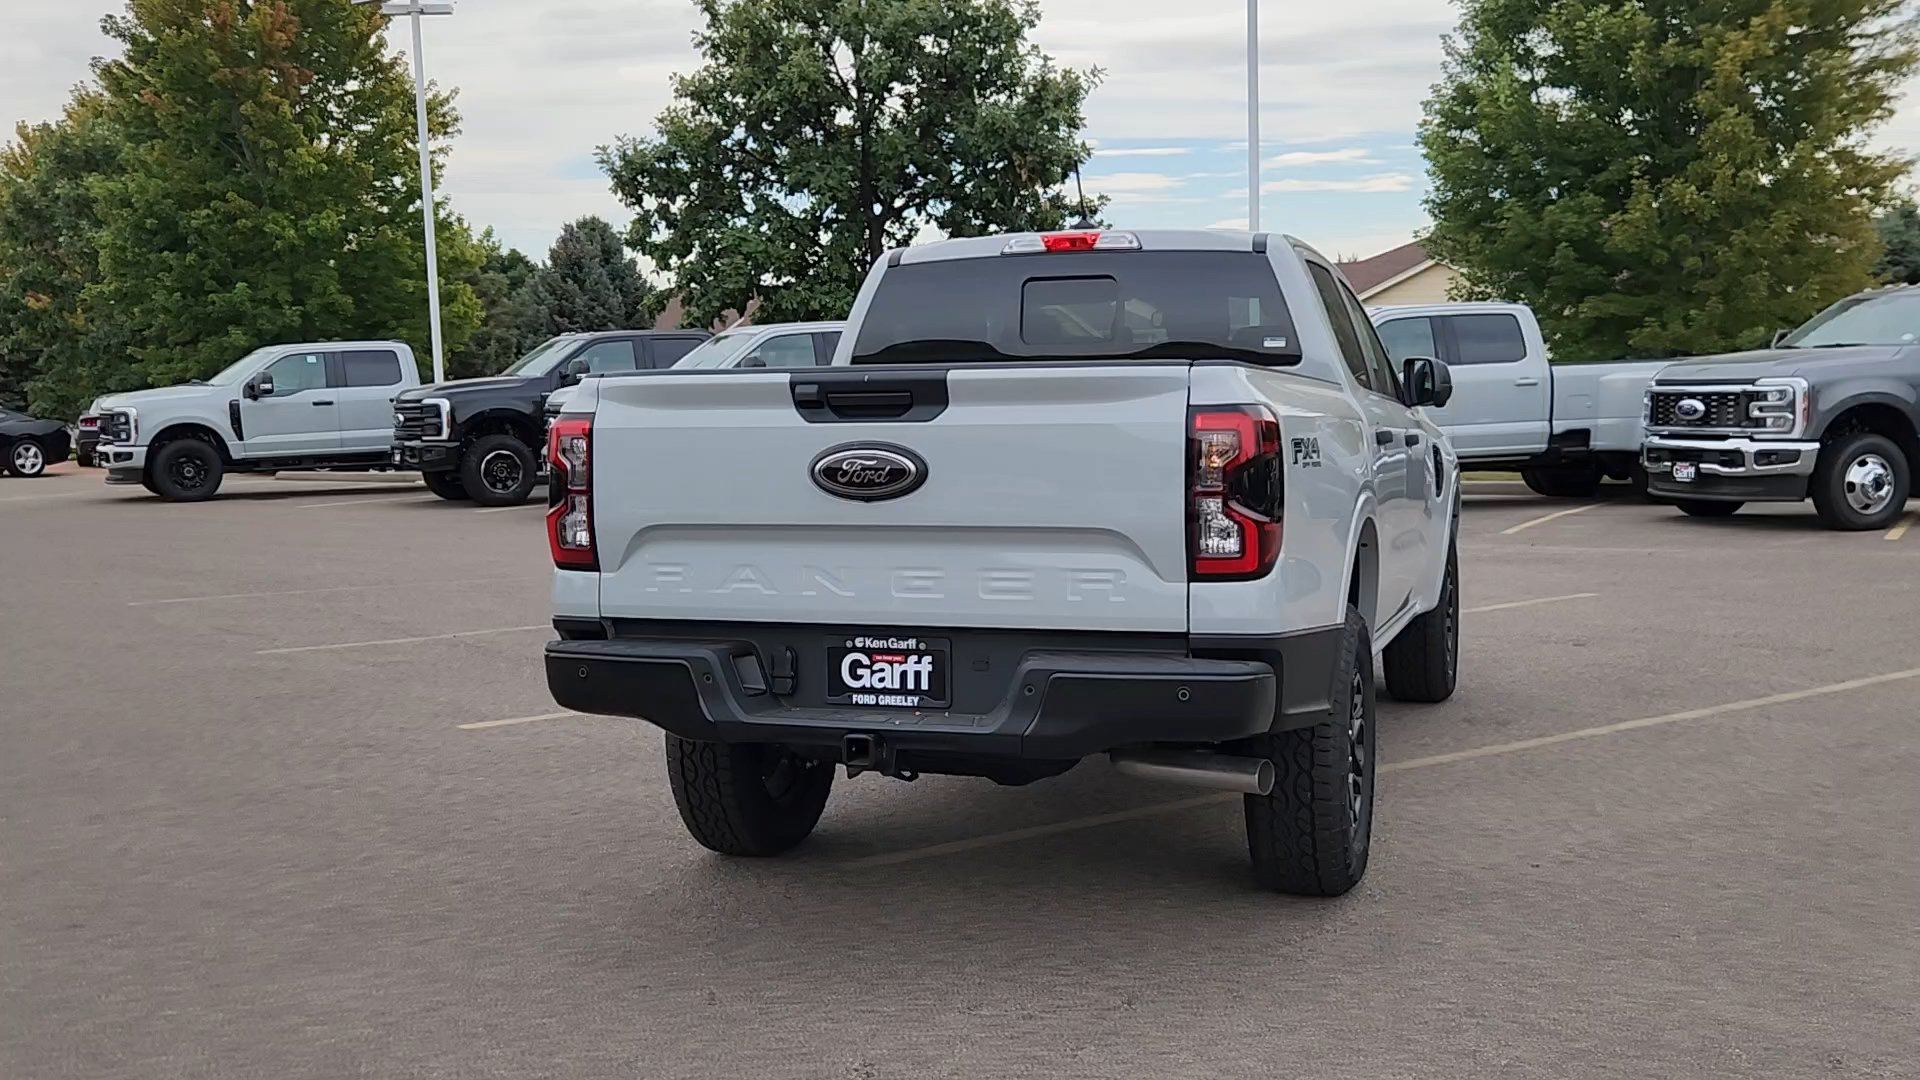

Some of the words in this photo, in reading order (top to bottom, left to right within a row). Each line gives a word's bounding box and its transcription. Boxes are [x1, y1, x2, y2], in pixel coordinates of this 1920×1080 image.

[1291, 438, 1320, 464] FX4
[837, 458, 891, 483] Ford
[644, 562, 1127, 602] RANGER
[865, 637, 887, 648] Ken
[888, 638, 917, 649] Garff
[841, 652, 933, 690] Garff
[852, 694, 876, 705] FORD
[878, 695, 919, 706] GREELEY
